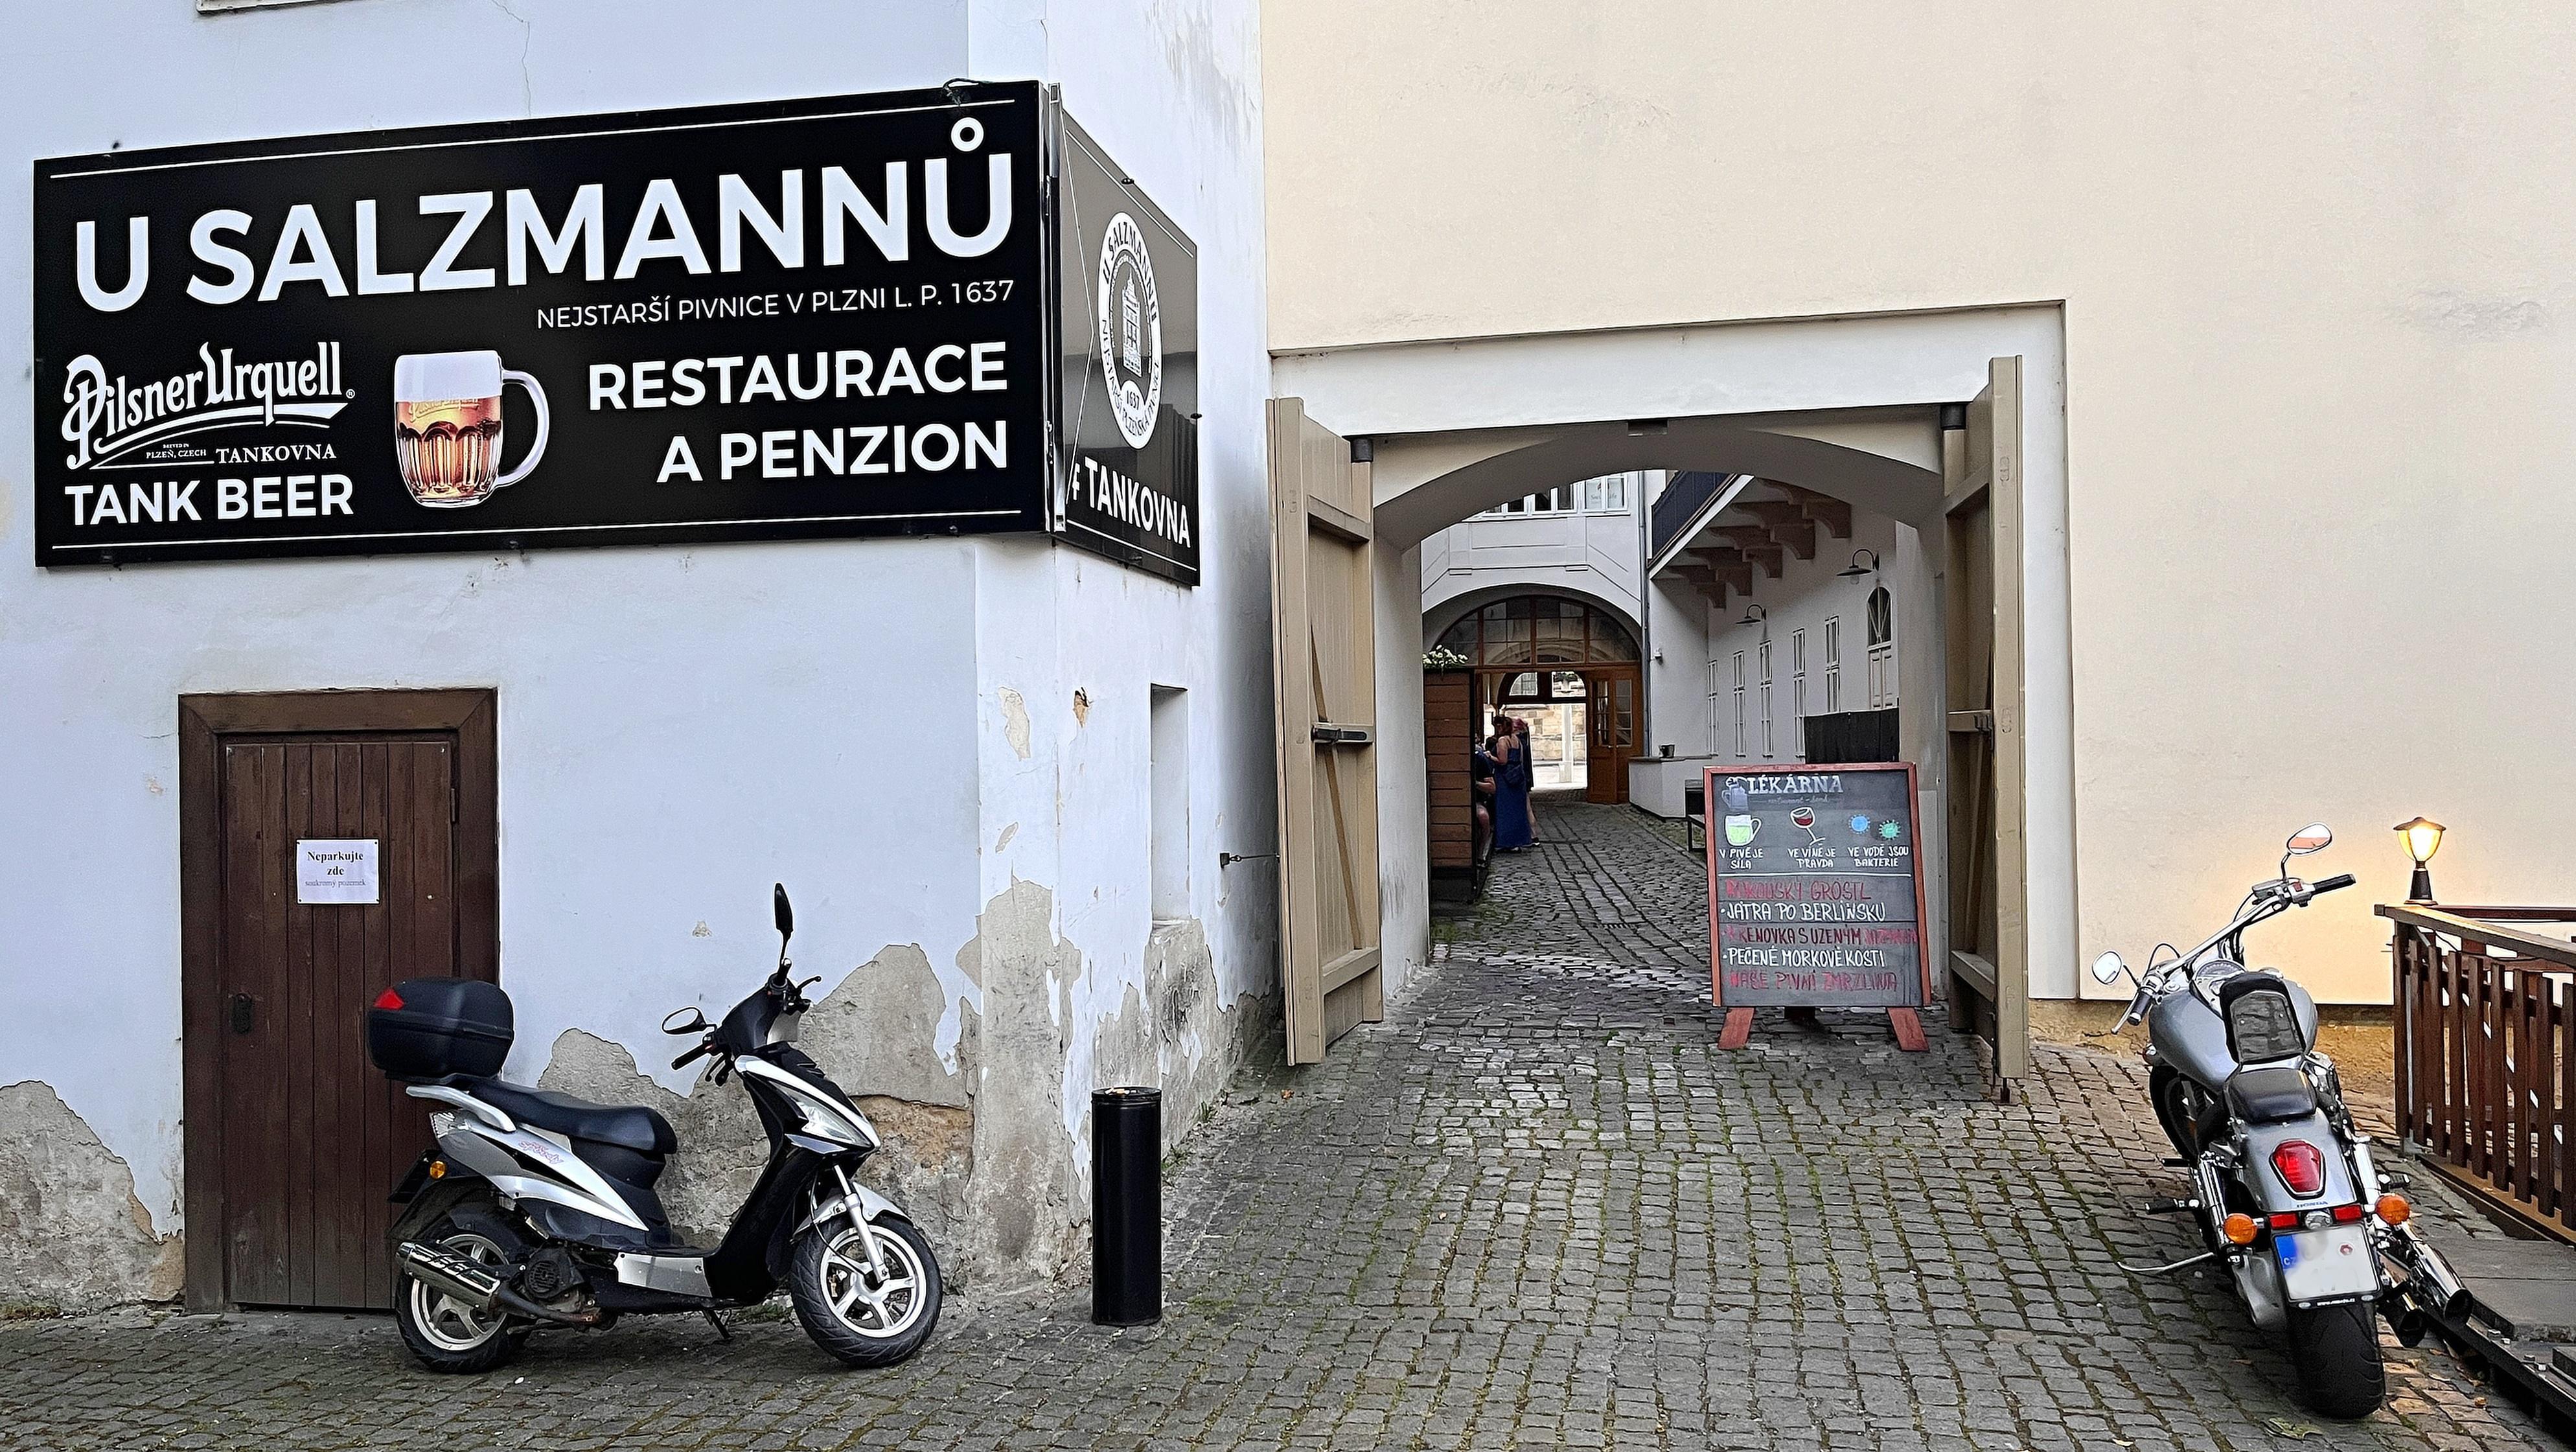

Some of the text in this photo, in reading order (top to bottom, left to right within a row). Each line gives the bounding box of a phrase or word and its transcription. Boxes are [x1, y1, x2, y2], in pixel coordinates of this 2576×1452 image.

[76, 117, 1012, 312] U SALZMANNŮ
[537, 280, 1015, 328] NEJSTARŠÍ PIVNICE V PLZNI L. P. 1637
[588, 341, 1008, 411] RESTAURACE
[62, 341, 342, 470] Pilsner Urquell
[216, 443, 337, 464] TANKOVNA
[656, 420, 1007, 483] A PENZION
[64, 474, 354, 525] TANK BEER
[1085, 456, 1191, 548] TANKOVNA
[1747, 774, 1844, 794] LÉKÁRNA
[308, 851, 363, 863] Neparkujte
[1719, 849, 1726, 859] V
[1752, 847, 1764, 859] JE
[1788, 847, 1799, 858] VE
[1825, 847, 1836, 858] JE
[1848, 846, 1859, 857] VE
[1888, 846, 1909, 857] JSOU
[327, 866, 345, 875] zde
[1731, 858, 1752, 870] SÍLA
[1796, 858, 1834, 869] PRAVDA
[1855, 857, 1898, 868] BAKTERIE
[1727, 901, 1771, 920] JÁTRA
[1775, 903, 1795, 920] PO
[1799, 927, 1809, 944] S
[1845, 950, 1886, 967] KOSTI
